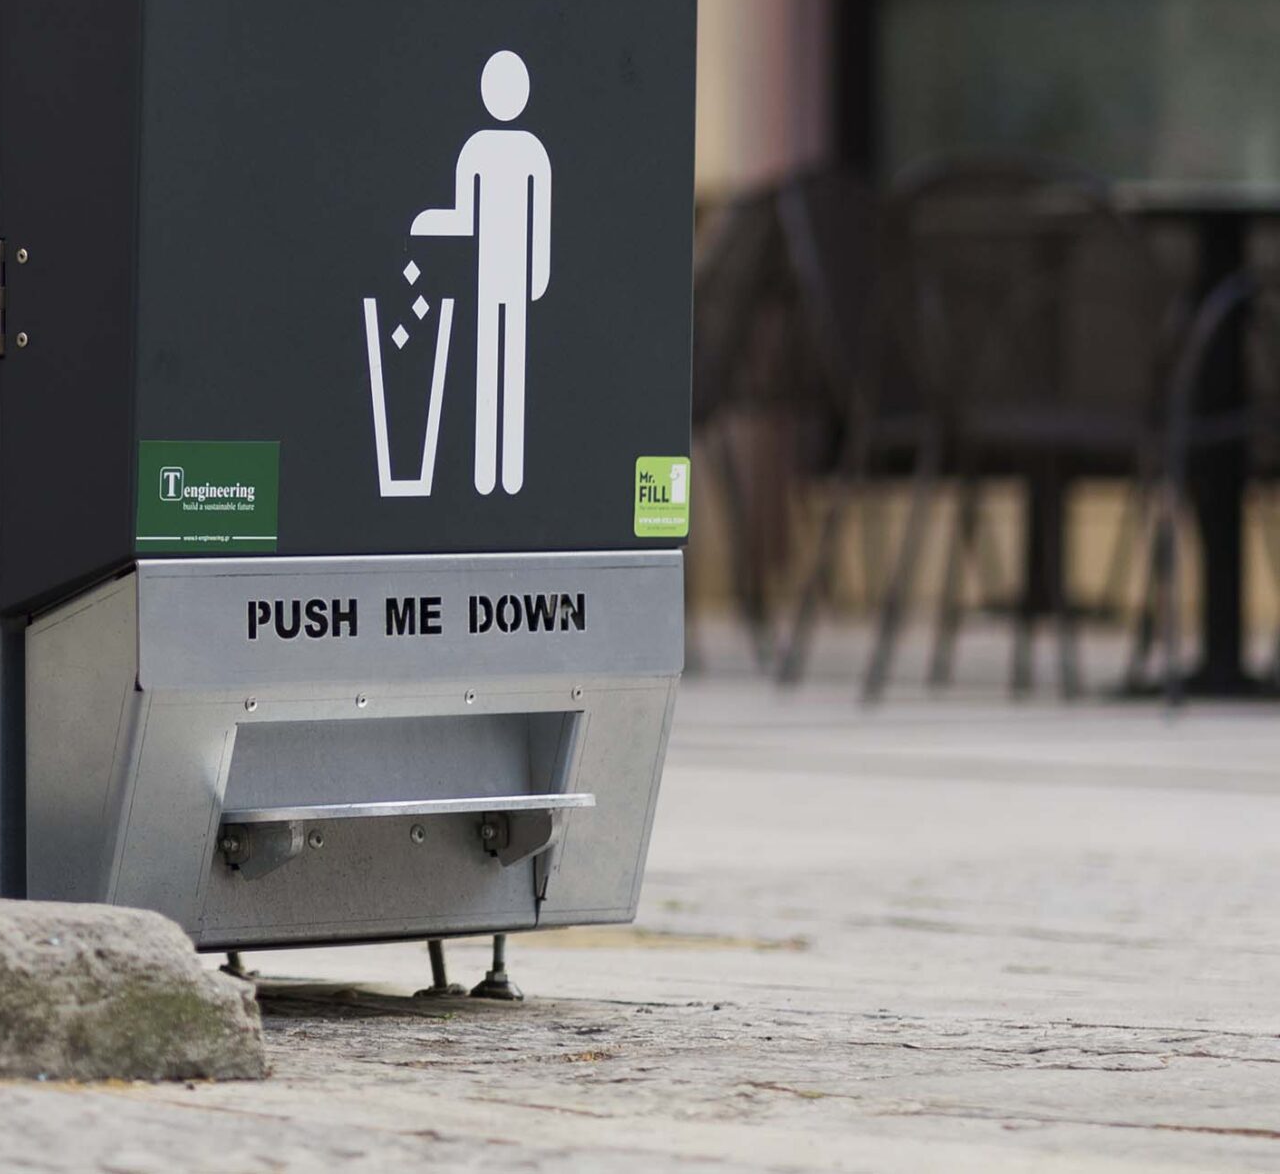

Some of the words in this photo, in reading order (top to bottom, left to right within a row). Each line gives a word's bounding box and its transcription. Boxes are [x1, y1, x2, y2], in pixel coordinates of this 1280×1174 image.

[639, 471, 656, 484] Mr.
[183, 482, 256, 502] engineering
[639, 485, 670, 503] FILL
[247, 598, 358, 640] PUSH
[385, 596, 442, 636] ME
[469, 593, 586, 634] DOWN
